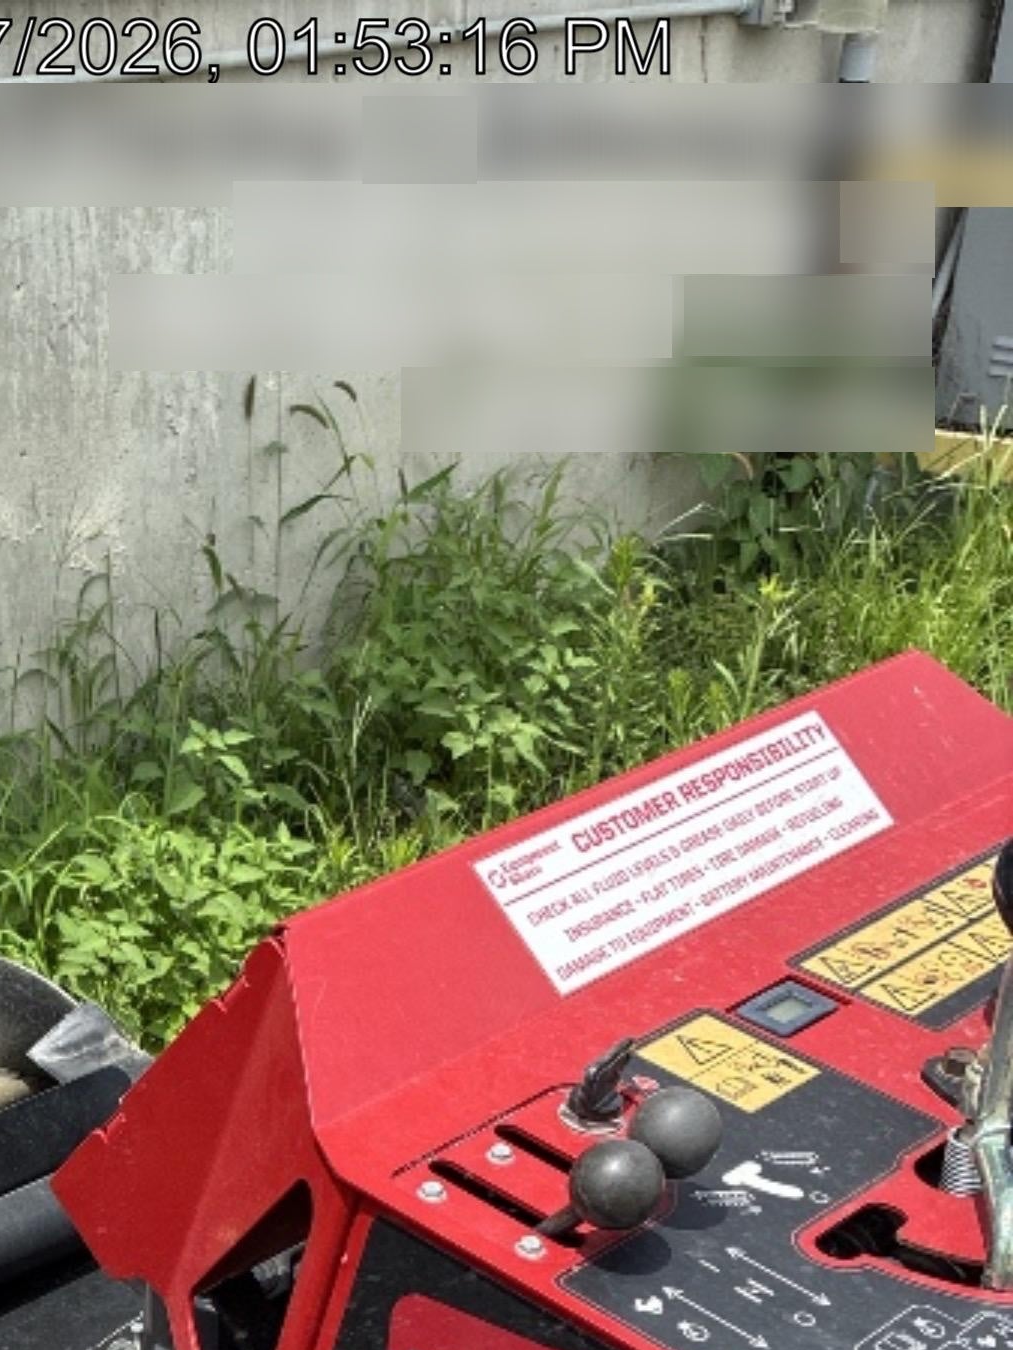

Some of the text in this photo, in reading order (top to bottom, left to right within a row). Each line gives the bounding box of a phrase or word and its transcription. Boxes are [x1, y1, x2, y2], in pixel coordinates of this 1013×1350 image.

[527, 898, 572, 927] CHECK
[569, 889, 593, 906] ALL
[592, 870, 630, 895] FLUID
[627, 848, 675, 878] LEVELS
[680, 824, 723, 852] GREASE
[722, 809, 755, 831] DAILY
[754, 789, 796, 816] BEFORE
[794, 774, 828, 796] START
[827, 766, 841, 780] UP
[571, 722, 825, 853] CUSTOMER RESPONSIBILITY
[556, 945, 612, 981] DAMAGE
[607, 936, 627, 952] TO
[625, 902, 695, 945] EQUIPMENT
[700, 875, 749, 907] BATTERY
[748, 837, 824, 882] MAINTENANCE
[827, 808, 880, 840] CLEANING
[563, 899, 636, 942] INSURANCE
[640, 880, 669, 903] FLAT
[666, 866, 705, 890] TIRES
[708, 849, 738, 870] TIRE
[734, 826, 782, 858] DAMAGE
[786, 797, 843, 831] REFUELING
